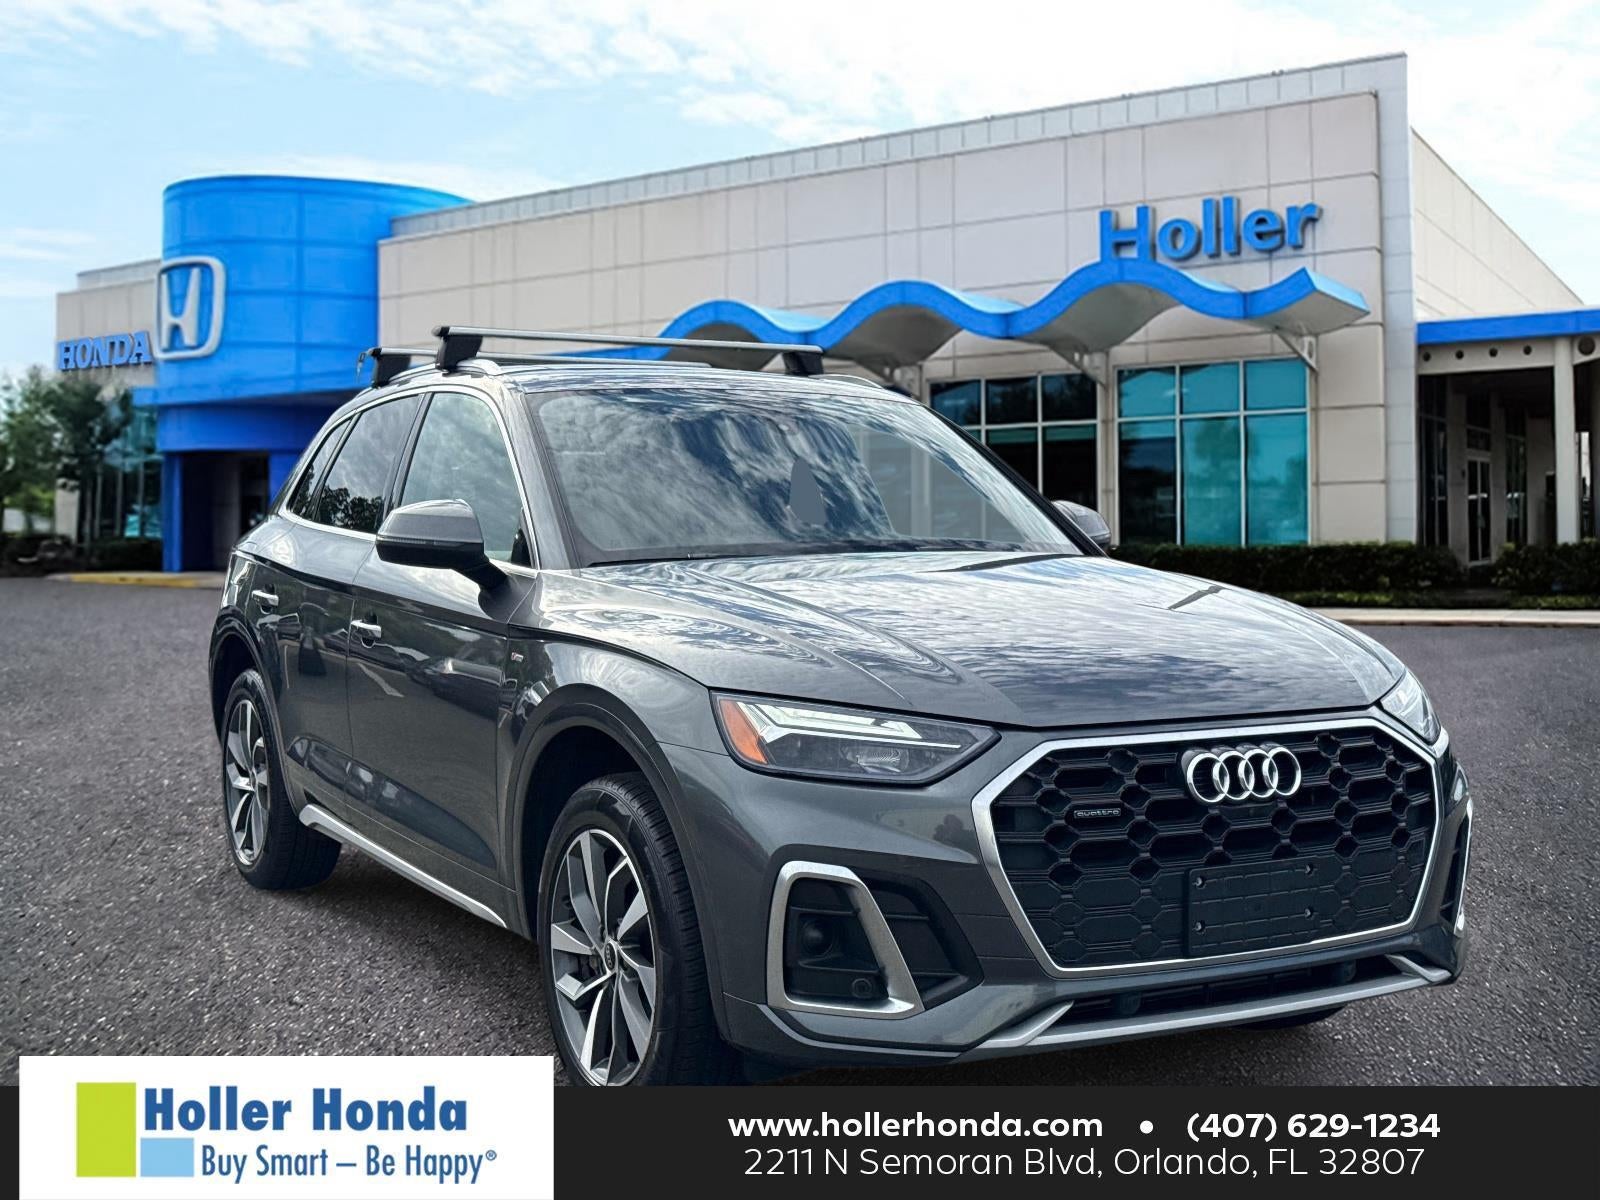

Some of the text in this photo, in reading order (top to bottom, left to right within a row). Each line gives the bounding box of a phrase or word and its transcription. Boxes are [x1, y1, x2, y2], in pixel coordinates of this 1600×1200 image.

[1099, 195, 1322, 261] Holler
[58, 330, 152, 371] HONDA
[1076, 809, 1120, 817] quattro
